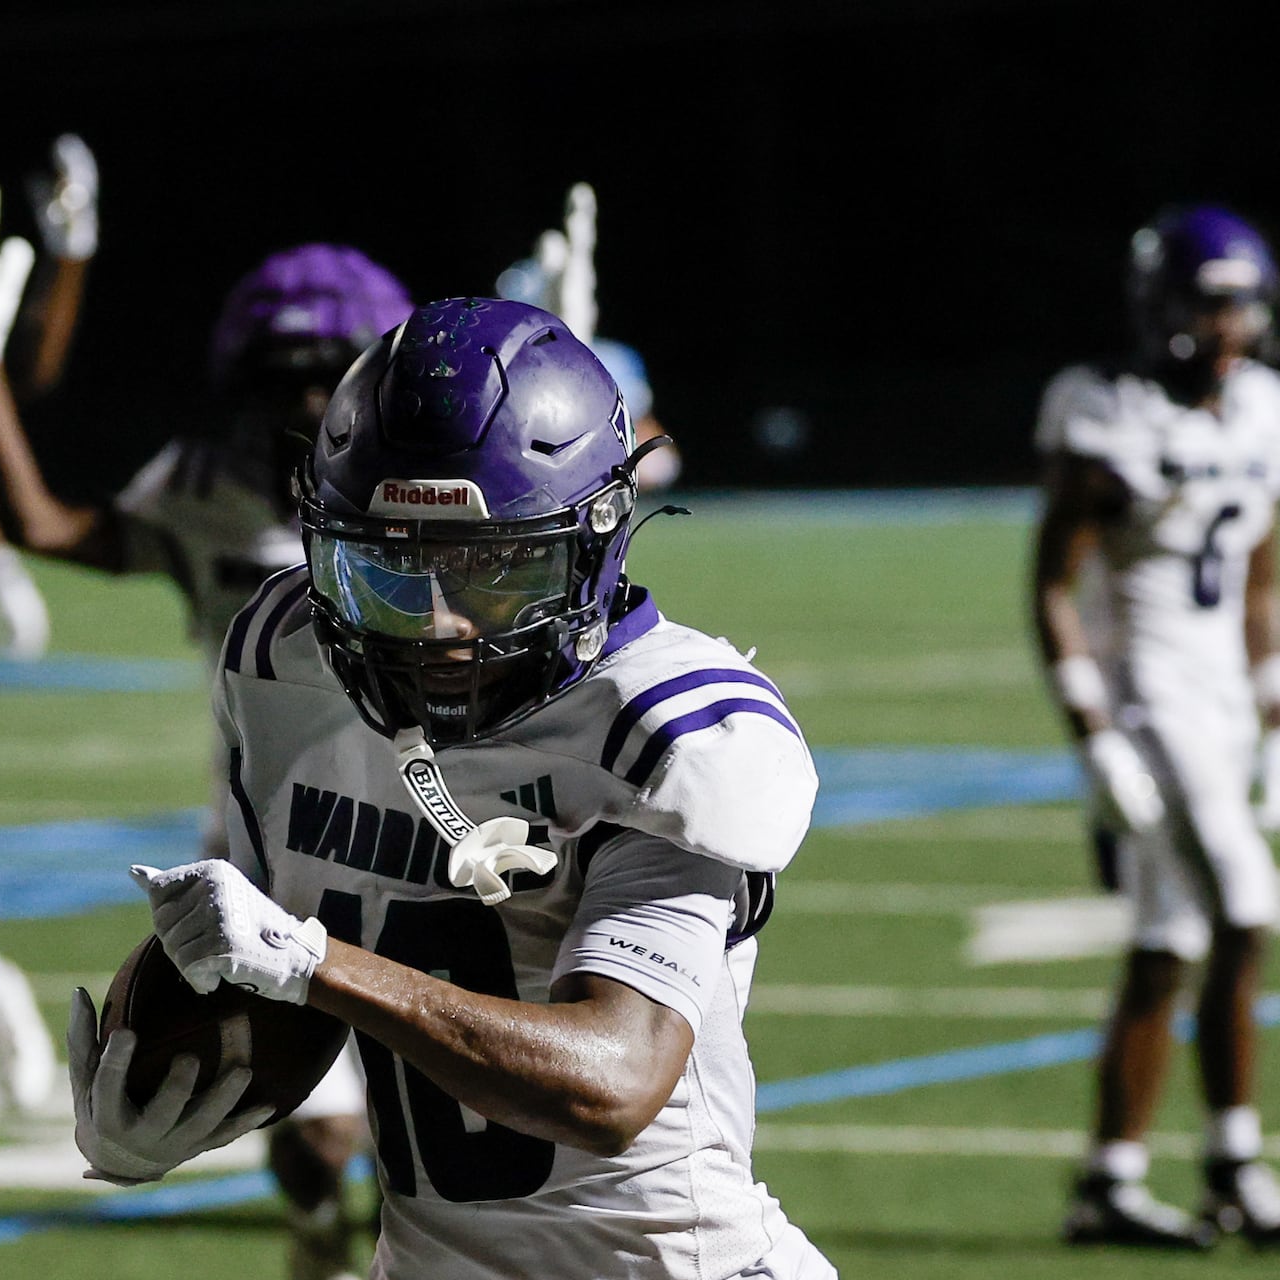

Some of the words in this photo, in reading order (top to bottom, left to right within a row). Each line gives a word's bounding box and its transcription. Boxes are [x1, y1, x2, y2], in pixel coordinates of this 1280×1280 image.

[383, 483, 470, 506] Riddell
[1191, 503, 1242, 608] 6
[412, 768, 470, 838] BATTLE
[609, 937, 648, 957] WE
[649, 952, 701, 988] BALL
[317, 887, 557, 1204] 10
